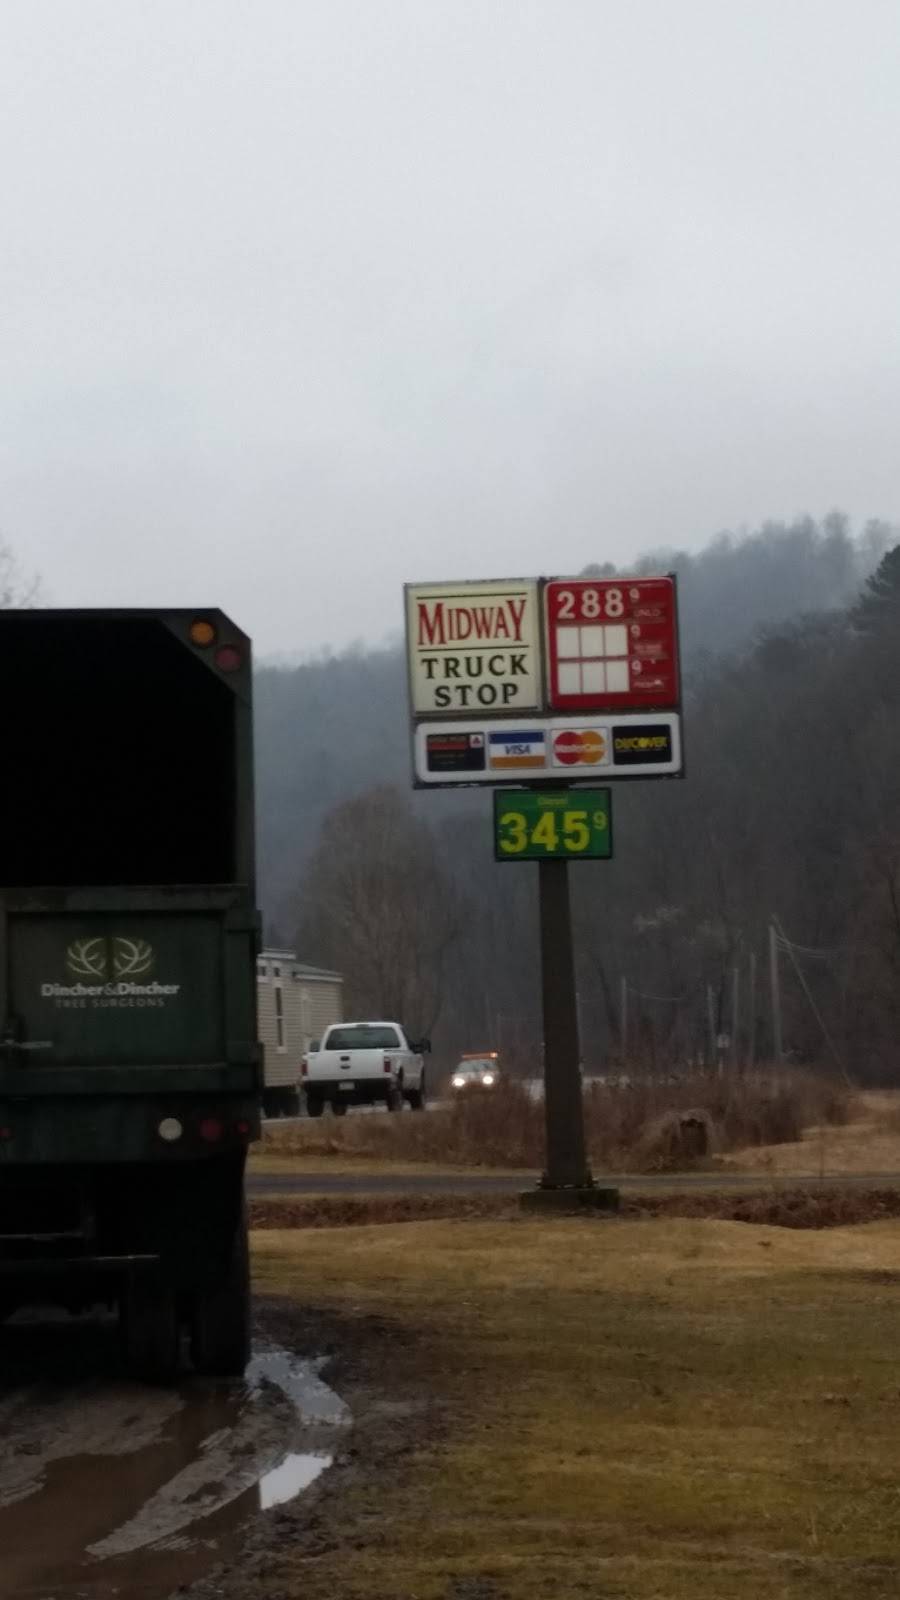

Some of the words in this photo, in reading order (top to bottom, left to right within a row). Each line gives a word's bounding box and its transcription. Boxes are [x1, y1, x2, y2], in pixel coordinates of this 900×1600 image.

[556, 588, 625, 619] 288
[417, 599, 526, 646] MIDWAY
[421, 654, 529, 679] TRUCK
[434, 684, 519, 708] STOP
[504, 743, 531, 755] VISA
[499, 811, 591, 853] 345
[592, 810, 607, 830] 9
[55, 998, 87, 1008] TREE
[93, 997, 166, 1008] SURGEONS
